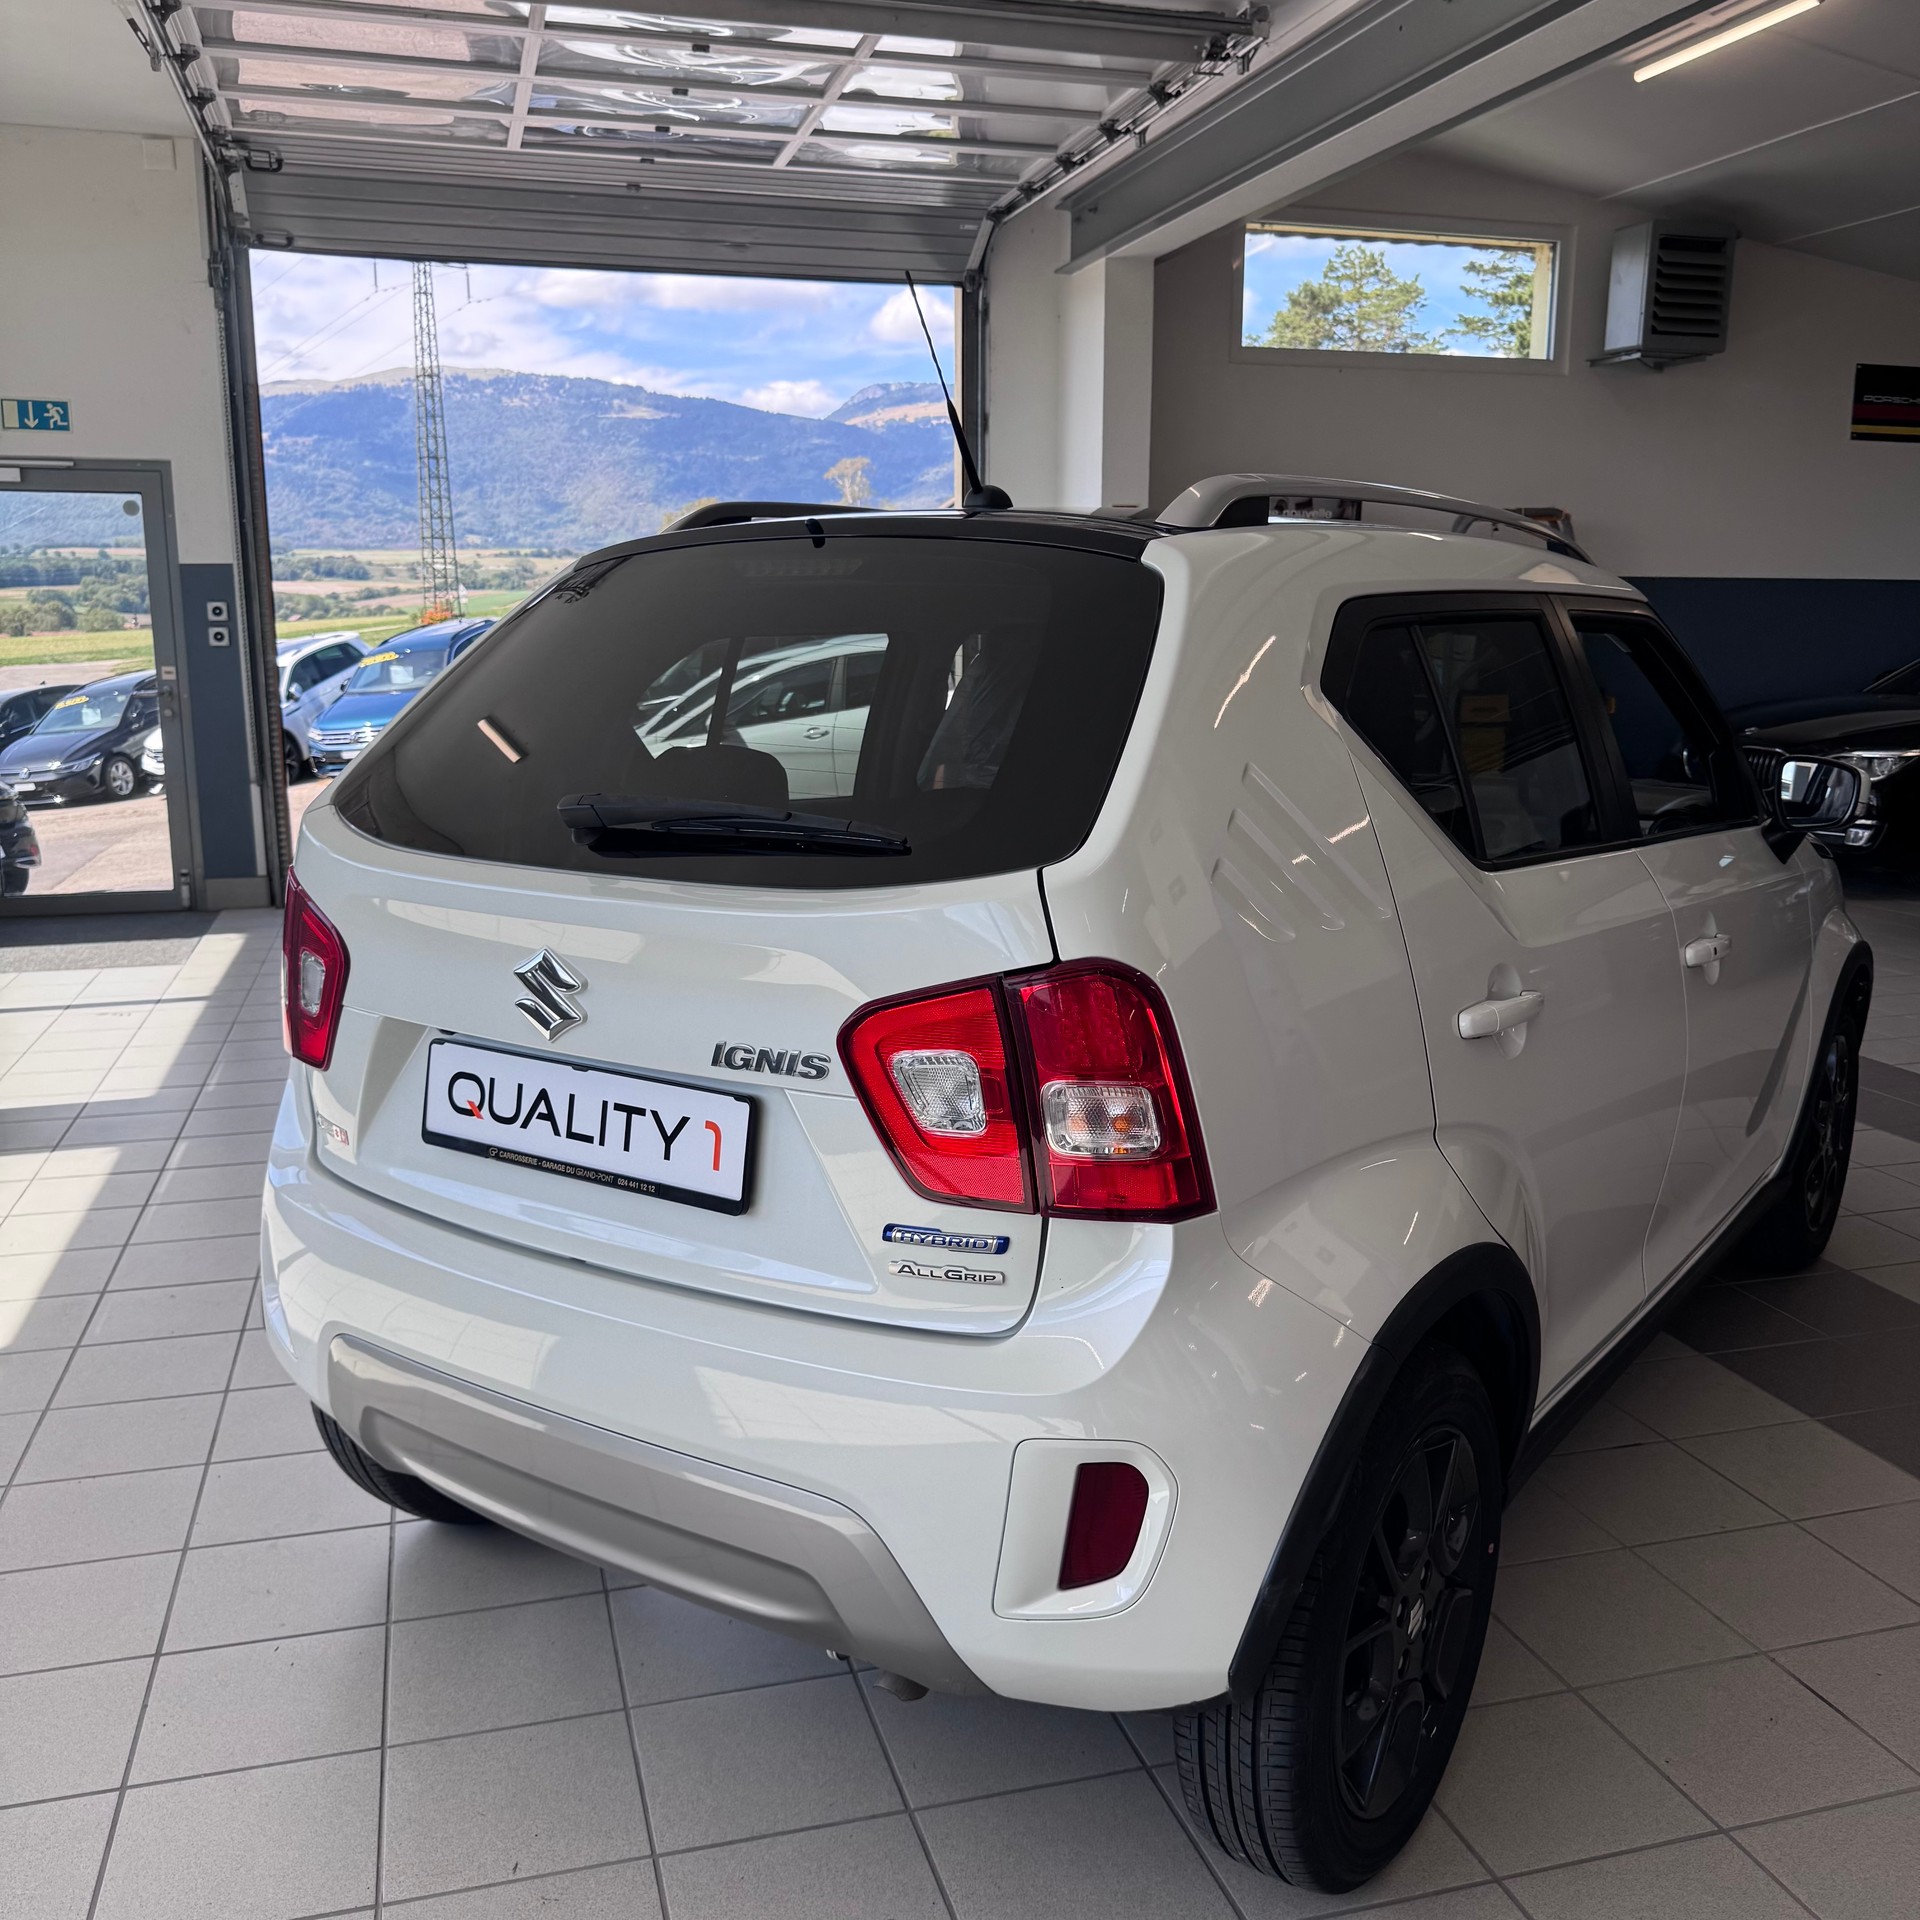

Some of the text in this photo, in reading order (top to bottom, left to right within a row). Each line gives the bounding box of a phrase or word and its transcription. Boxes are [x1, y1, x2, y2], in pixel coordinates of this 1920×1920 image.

[1863, 395, 1920, 405] PORSCH
[711, 1040, 832, 1081] IGNIS
[499, 1151, 538, 1166] CARROSSERIE
[542, 1160, 566, 1172] GARAGE
[566, 1166, 576, 1174] DU
[575, 1168, 615, 1184] GRAND-PONT
[617, 1177, 628, 1186] 024
[629, 1181, 639, 1189] 441
[640, 1183, 647, 1191] 12
[648, 1185, 656, 1193] 12
[899, 1230, 990, 1249] HYBRID
